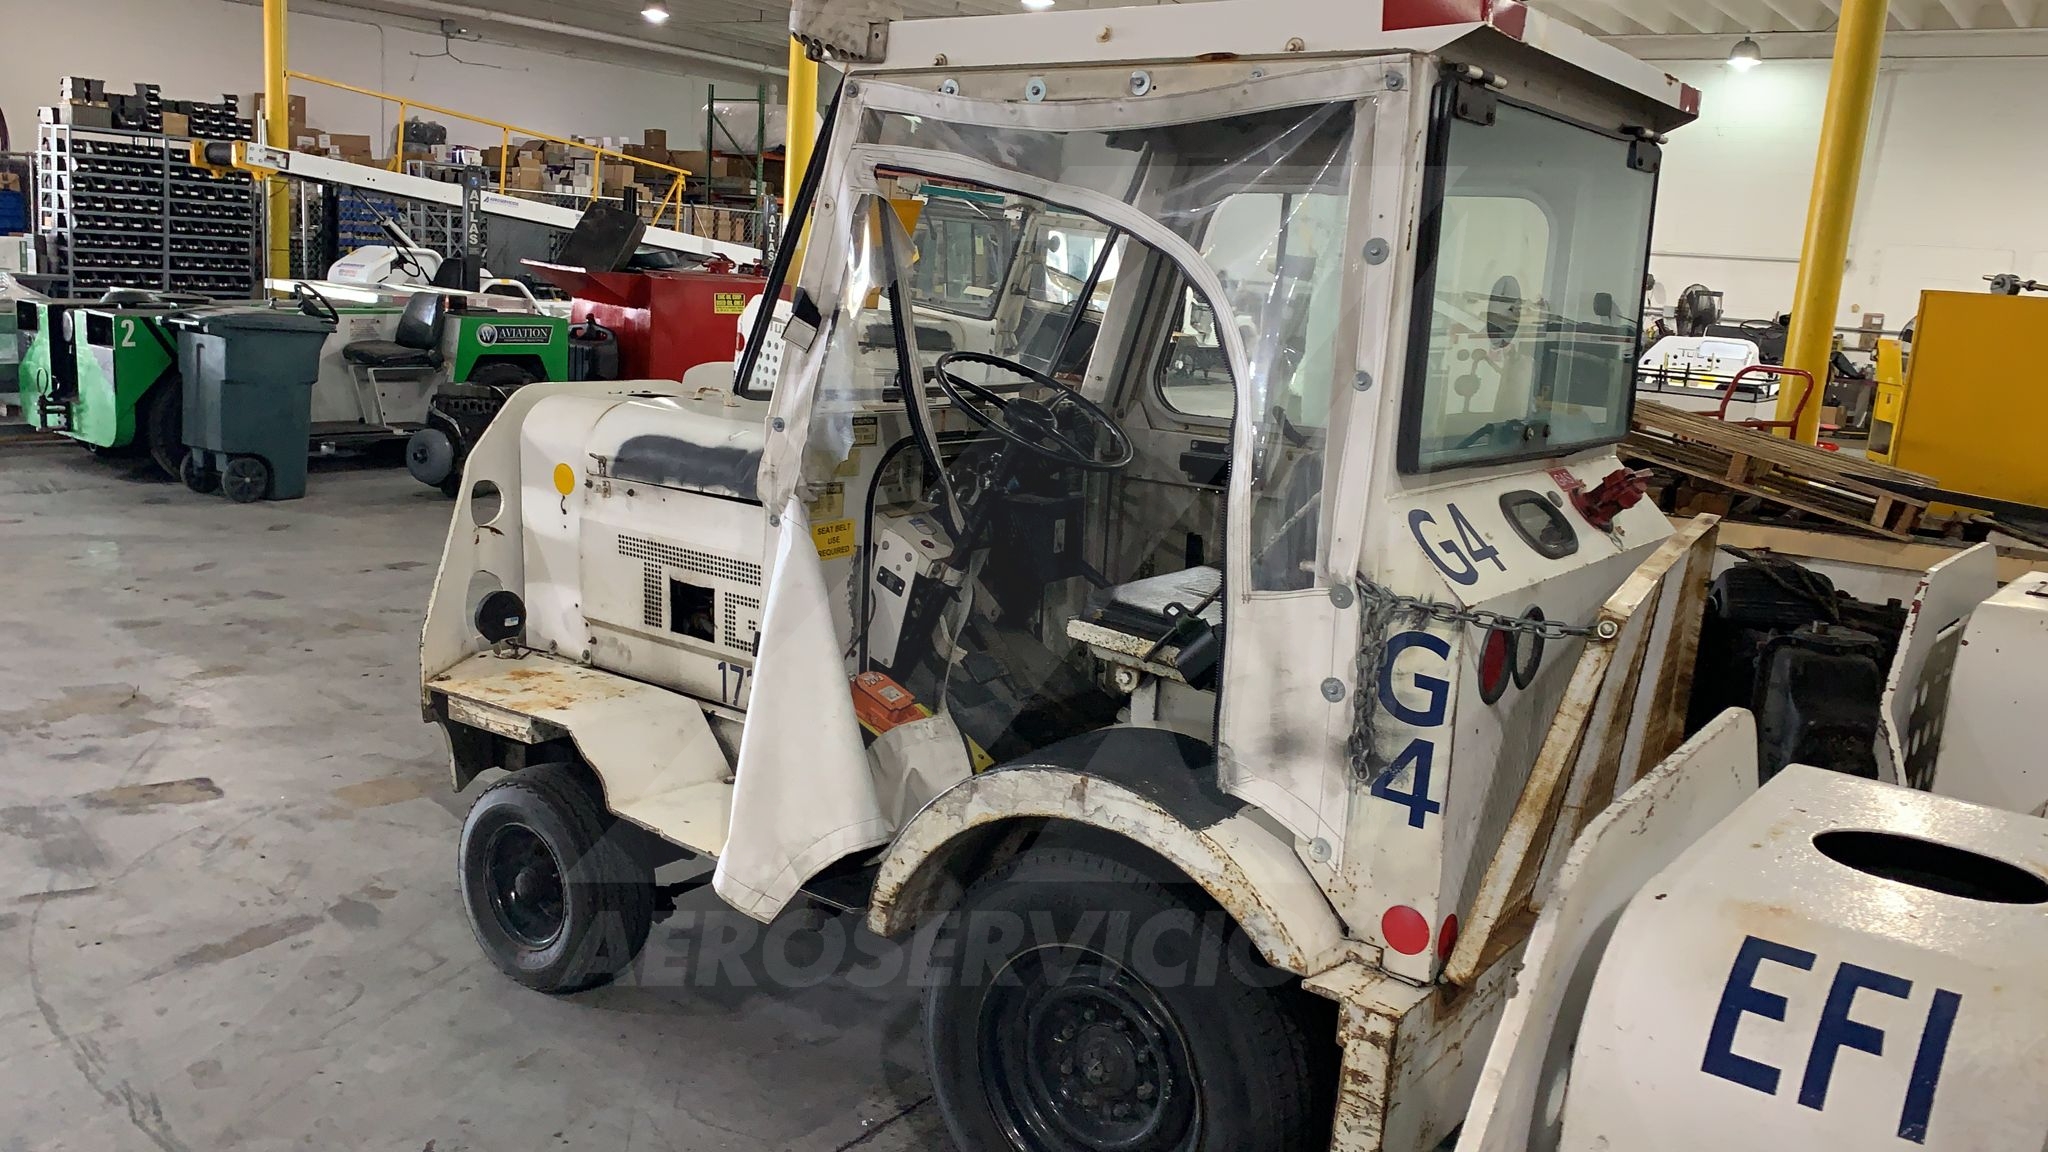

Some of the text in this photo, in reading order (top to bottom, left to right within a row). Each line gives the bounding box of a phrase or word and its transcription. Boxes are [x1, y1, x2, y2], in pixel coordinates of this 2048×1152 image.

[469, 189, 480, 245] ATLAS
[768, 215, 776, 261] ATLAS
[121, 319, 136, 347] 2
[499, 328, 548, 338] AVIATION
[817, 522, 851, 536] SEAT BELT
[827, 536, 841, 545] USE
[817, 545, 850, 557] REQUIRED
[1408, 503, 1507, 586] G4
[1700, 934, 1963, 1145] EFI
